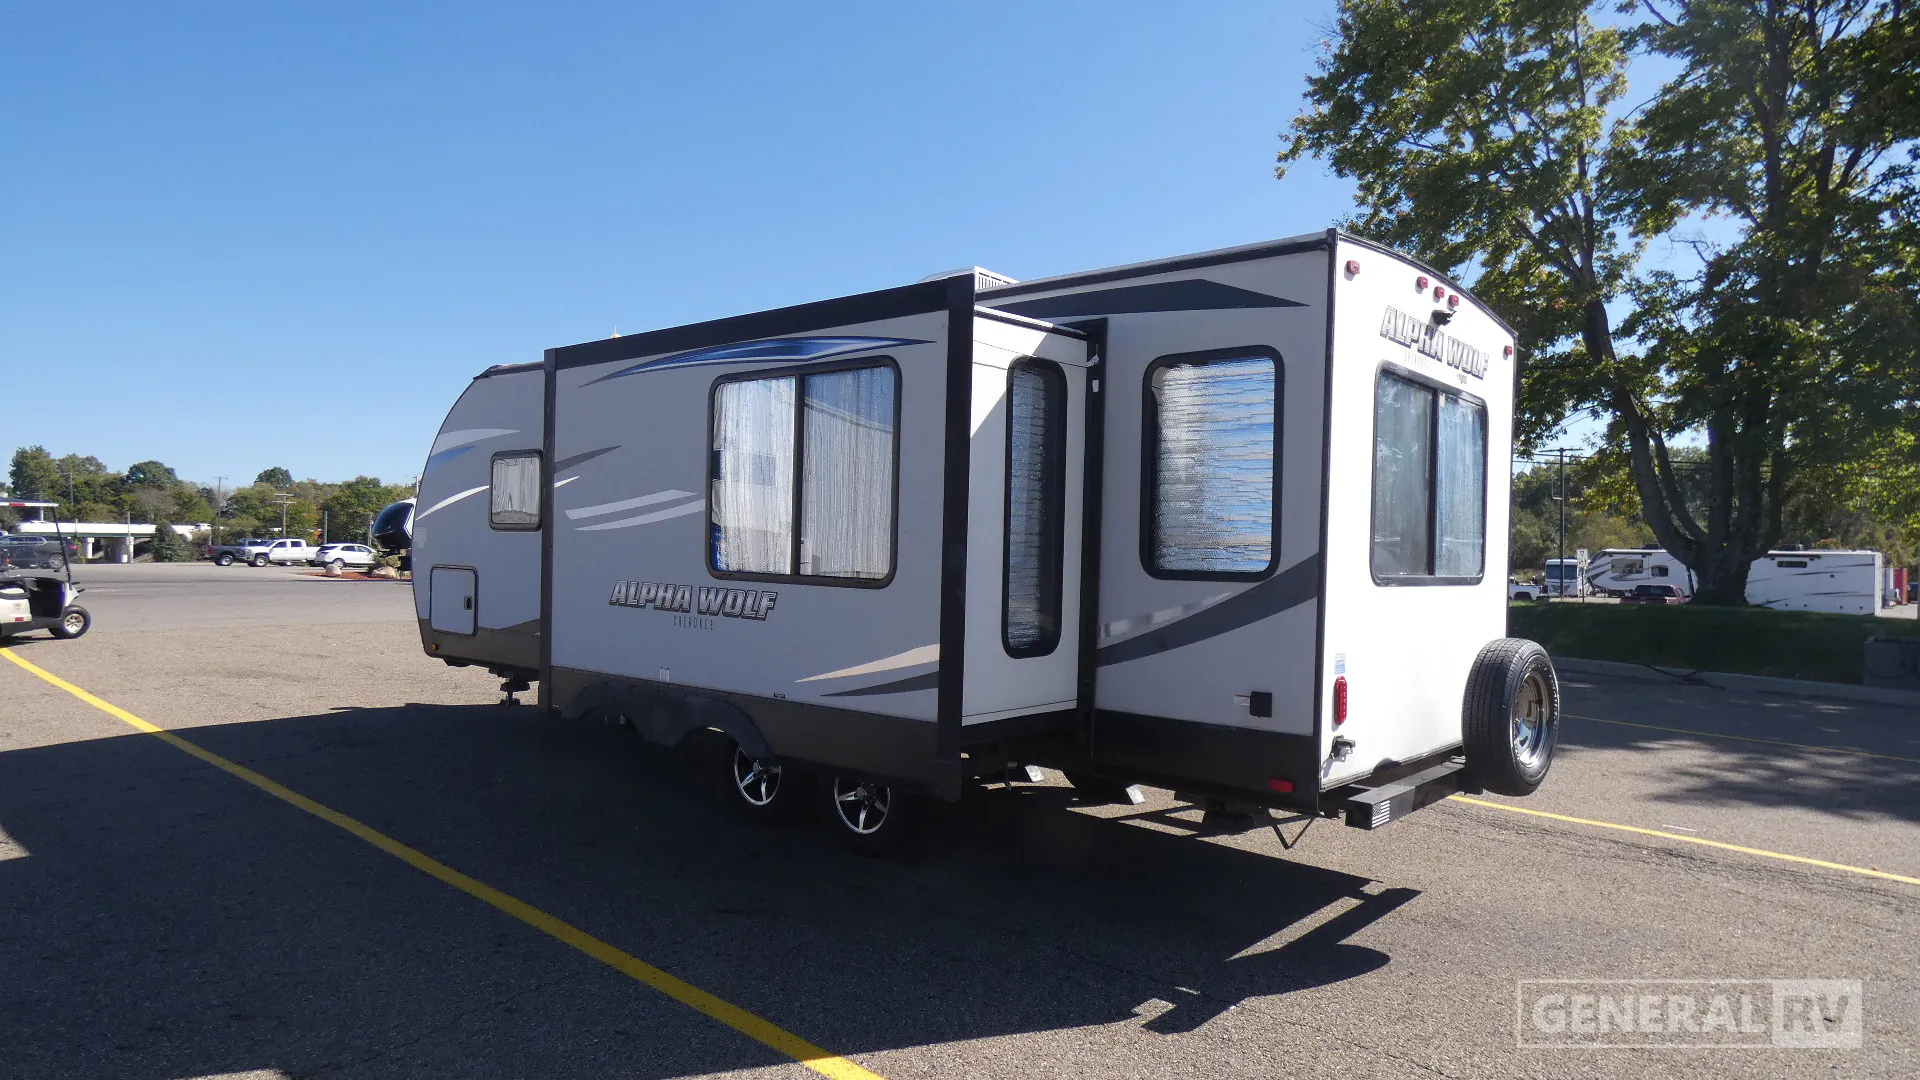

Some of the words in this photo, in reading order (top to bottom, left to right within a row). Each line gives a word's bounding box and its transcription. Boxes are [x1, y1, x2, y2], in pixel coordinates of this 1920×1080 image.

[1380, 305, 1444, 363] ALPHA
[1447, 336, 1489, 380] WOLF
[609, 580, 692, 613] ALPHA
[697, 587, 778, 621] WOLF
